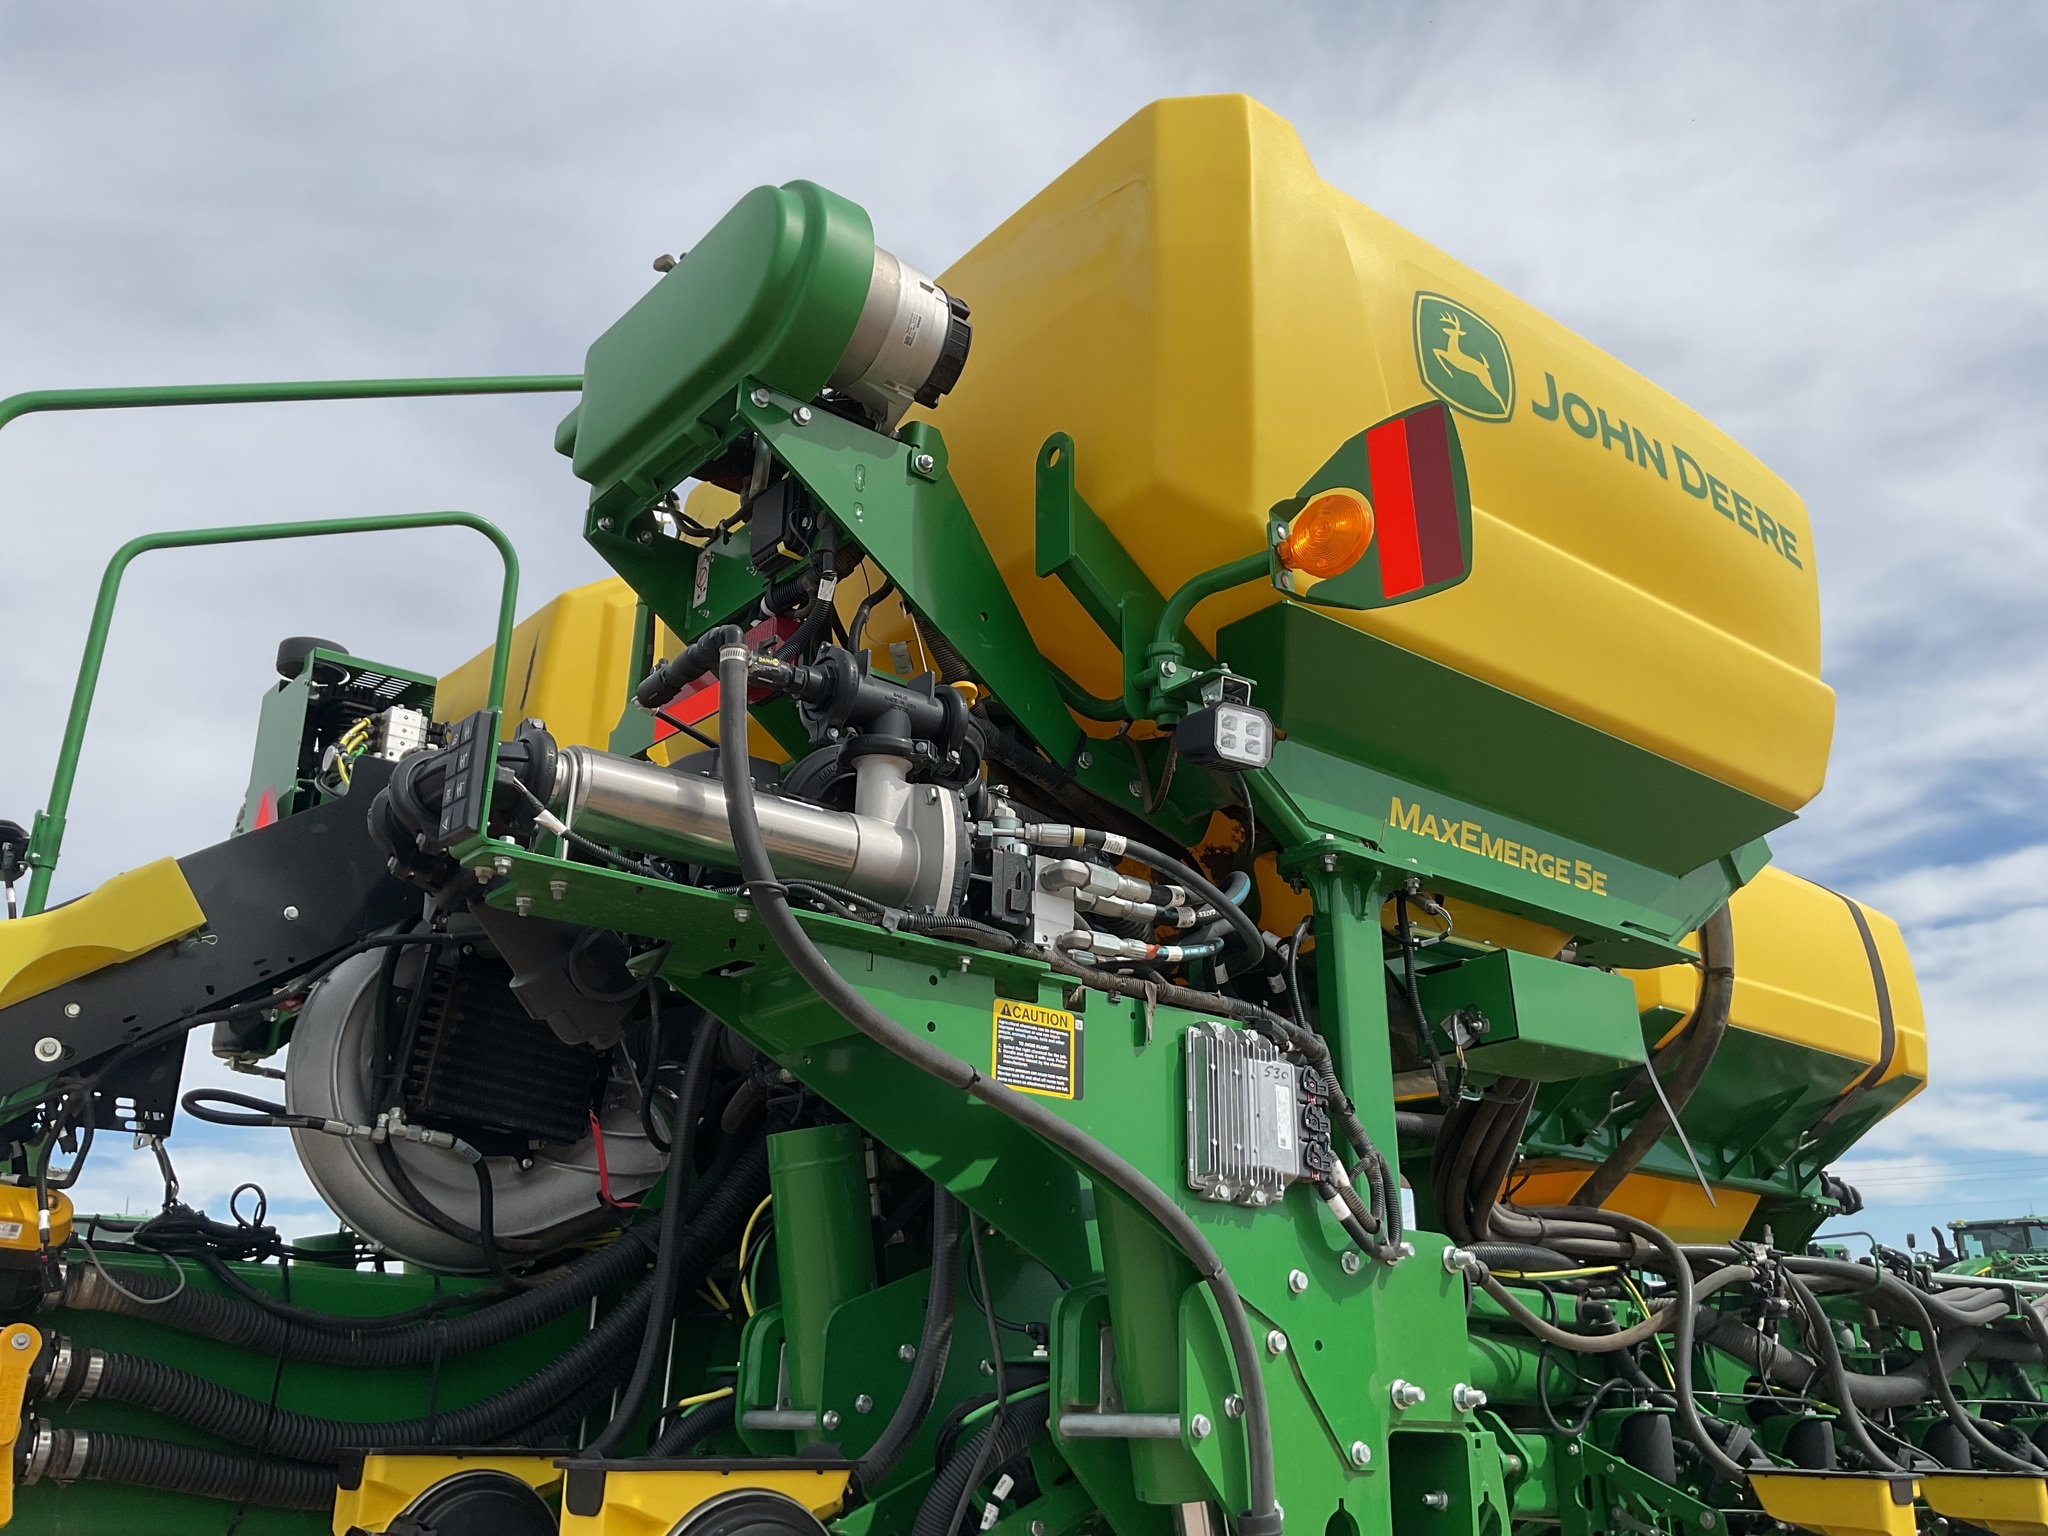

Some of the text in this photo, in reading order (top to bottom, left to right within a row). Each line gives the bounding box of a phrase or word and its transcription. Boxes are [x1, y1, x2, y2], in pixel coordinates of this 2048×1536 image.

[1531, 371, 1803, 571] JOHN DEERE
[1574, 859, 1608, 897] 5E
[1012, 1006, 1068, 1028] CAUTION
